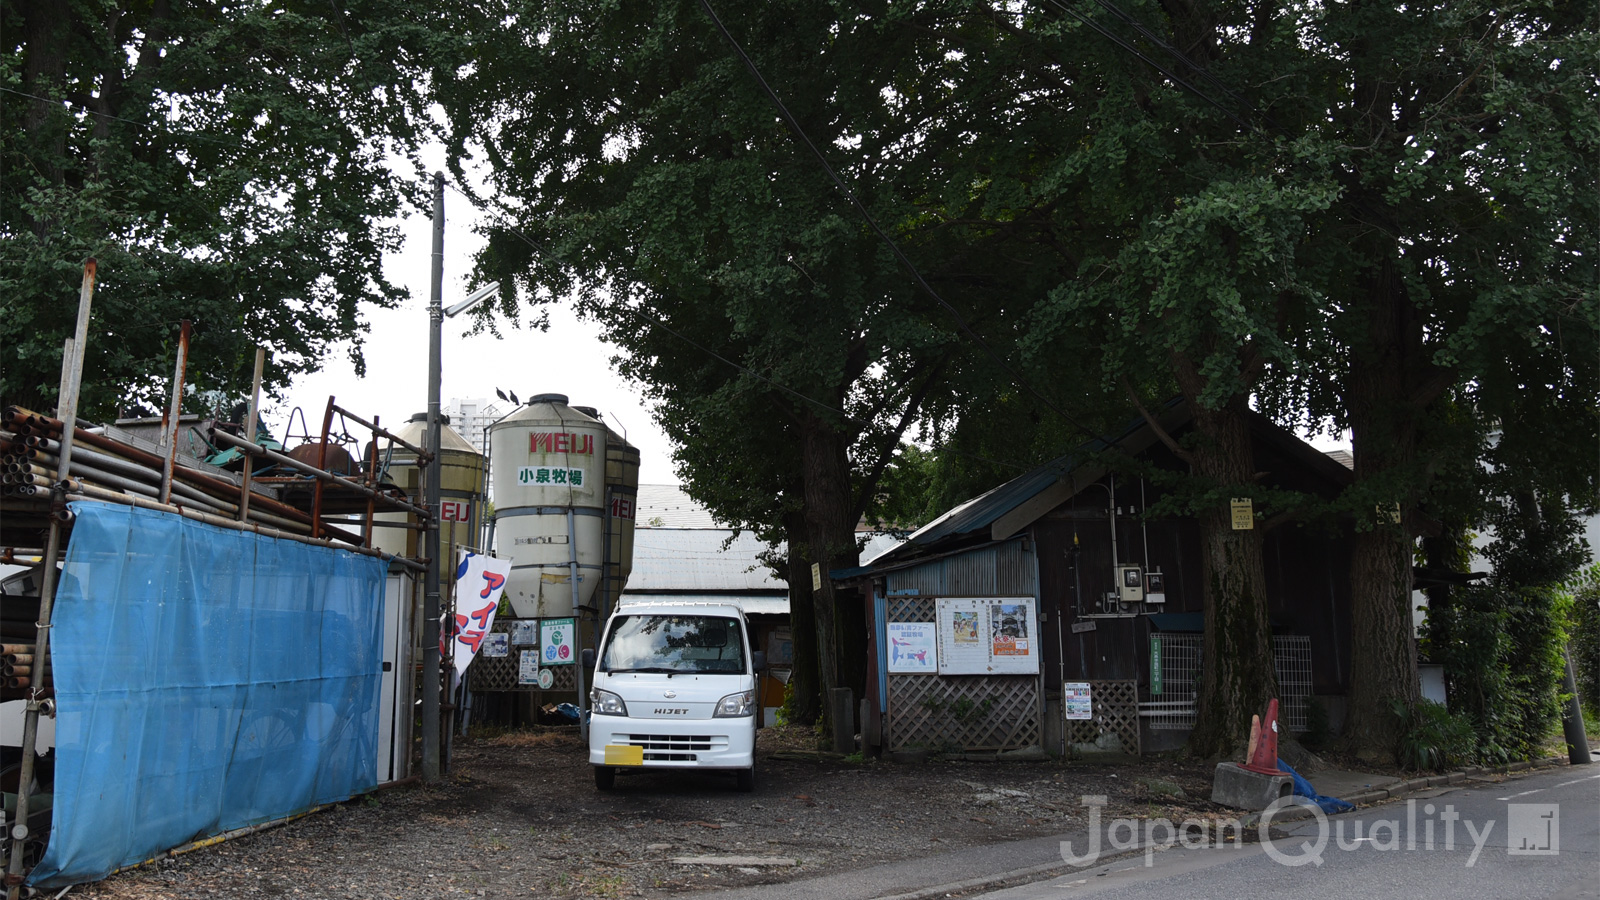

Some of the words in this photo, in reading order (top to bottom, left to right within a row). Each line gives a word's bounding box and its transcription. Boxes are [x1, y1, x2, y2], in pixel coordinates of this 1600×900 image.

[529, 431, 594, 455] MEIJI
[519, 467, 583, 486] 小泉牧場
[441, 501, 470, 522] EIJ
